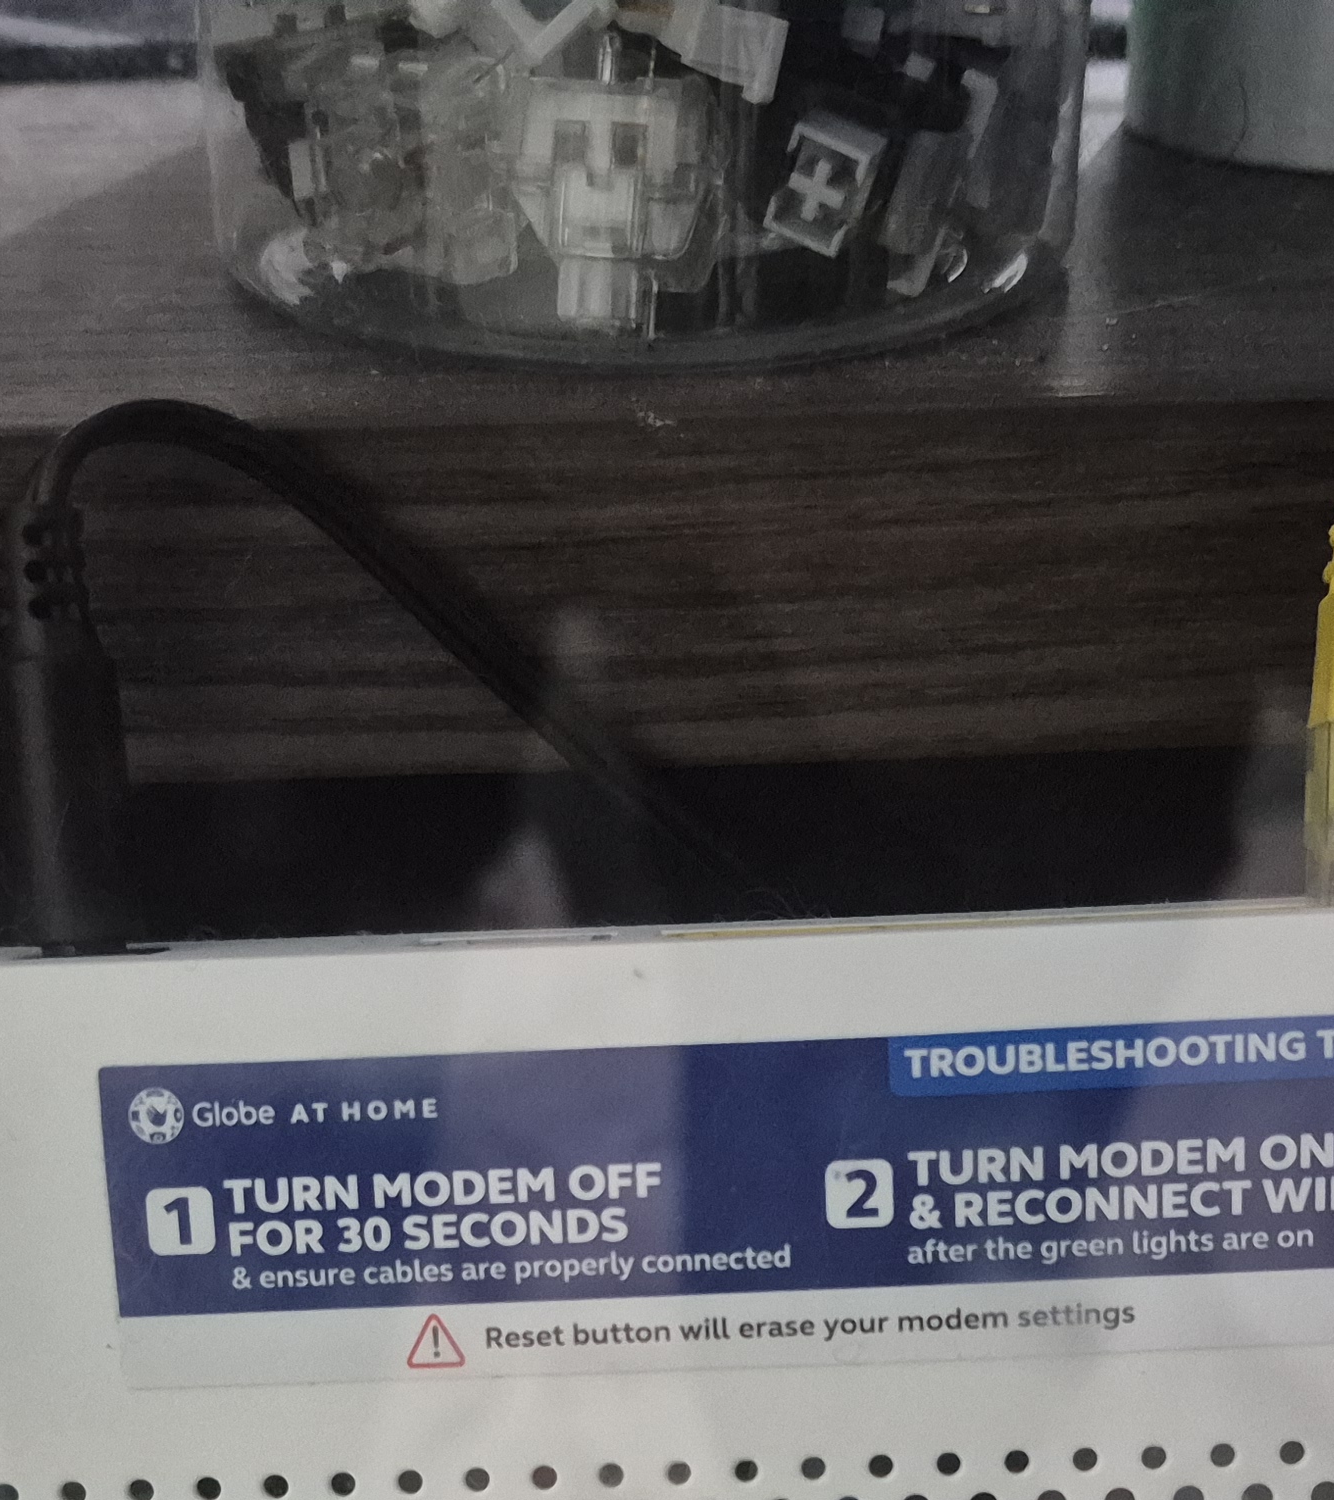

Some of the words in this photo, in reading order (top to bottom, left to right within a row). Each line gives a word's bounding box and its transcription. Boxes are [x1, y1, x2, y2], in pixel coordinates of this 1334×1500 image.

[904, 1031, 1307, 1079] TROUBLESHOOTING
[191, 1100, 276, 1128] Globe
[290, 1102, 328, 1124] AT
[342, 1098, 438, 1122] HOME
[908, 1146, 1044, 1187] TURN
[1059, 1137, 1247, 1181] MODEM
[1260, 1132, 1334, 1170] ON
[223, 1174, 359, 1215] TURN
[374, 1166, 556, 1211] MODEM
[568, 1162, 663, 1200] OFF
[909, 1194, 942, 1231] &
[954, 1179, 1253, 1228] RECONNECT
[228, 1219, 323, 1257] FOR
[338, 1215, 391, 1253] 30
[403, 1207, 629, 1250] SECONDS
[907, 1239, 977, 1266] after
[984, 1236, 1033, 1261] the
[1041, 1234, 1124, 1266] green
[1132, 1228, 1214, 1262] lights
[1222, 1230, 1269, 1252] are
[1276, 1227, 1314, 1249] on
[232, 1267, 252, 1289] &
[260, 1265, 356, 1289] ensure
[363, 1259, 454, 1285] cables
[461, 1260, 506, 1281] are
[514, 1250, 634, 1286] properly
[641, 1244, 792, 1274] connected
[485, 1325, 564, 1349] Reset
[573, 1320, 670, 1347] button
[678, 1317, 730, 1340] will
[739, 1316, 815, 1338] erase
[823, 1313, 888, 1342] your
[898, 1303, 1009, 1332] modem
[1017, 1301, 1136, 1331] settings
